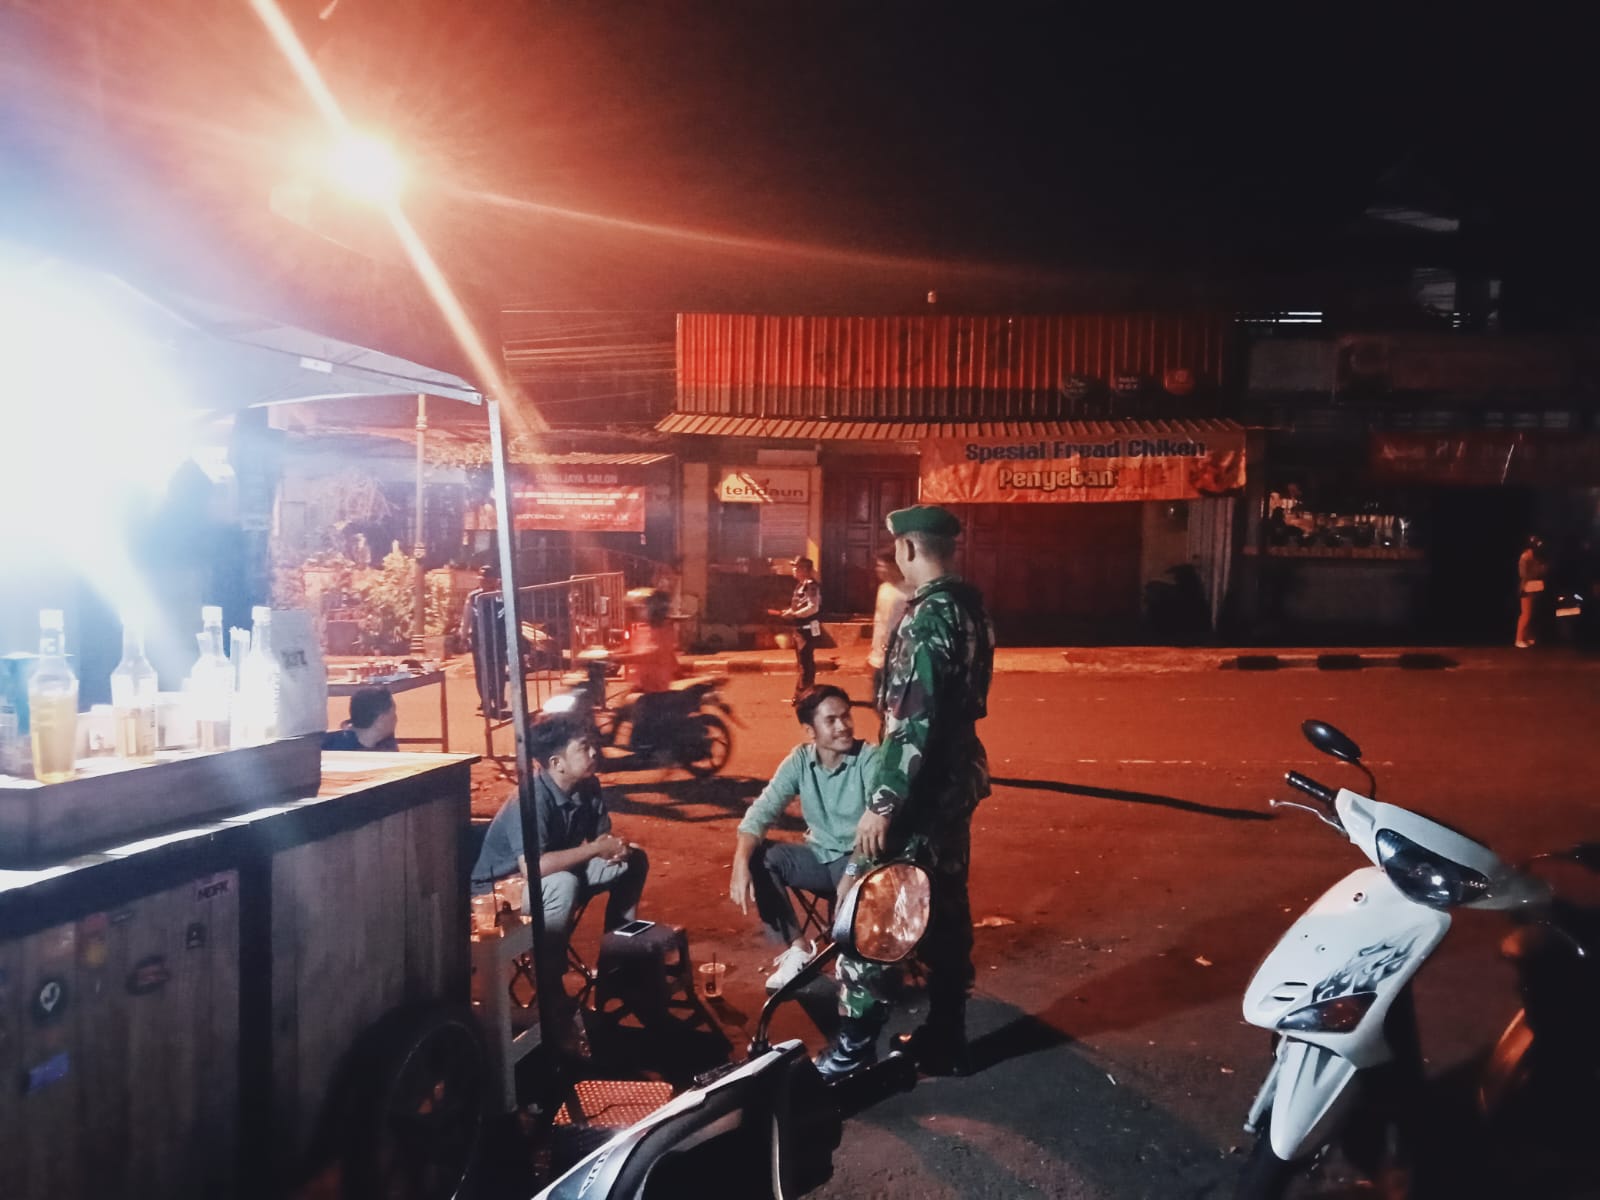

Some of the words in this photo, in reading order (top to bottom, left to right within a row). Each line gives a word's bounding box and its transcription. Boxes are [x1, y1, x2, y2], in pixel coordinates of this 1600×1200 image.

[966, 443, 1046, 464] Spesial
[1128, 439, 1206, 457] Chiken
[998, 467, 1116, 491] Penyetan
